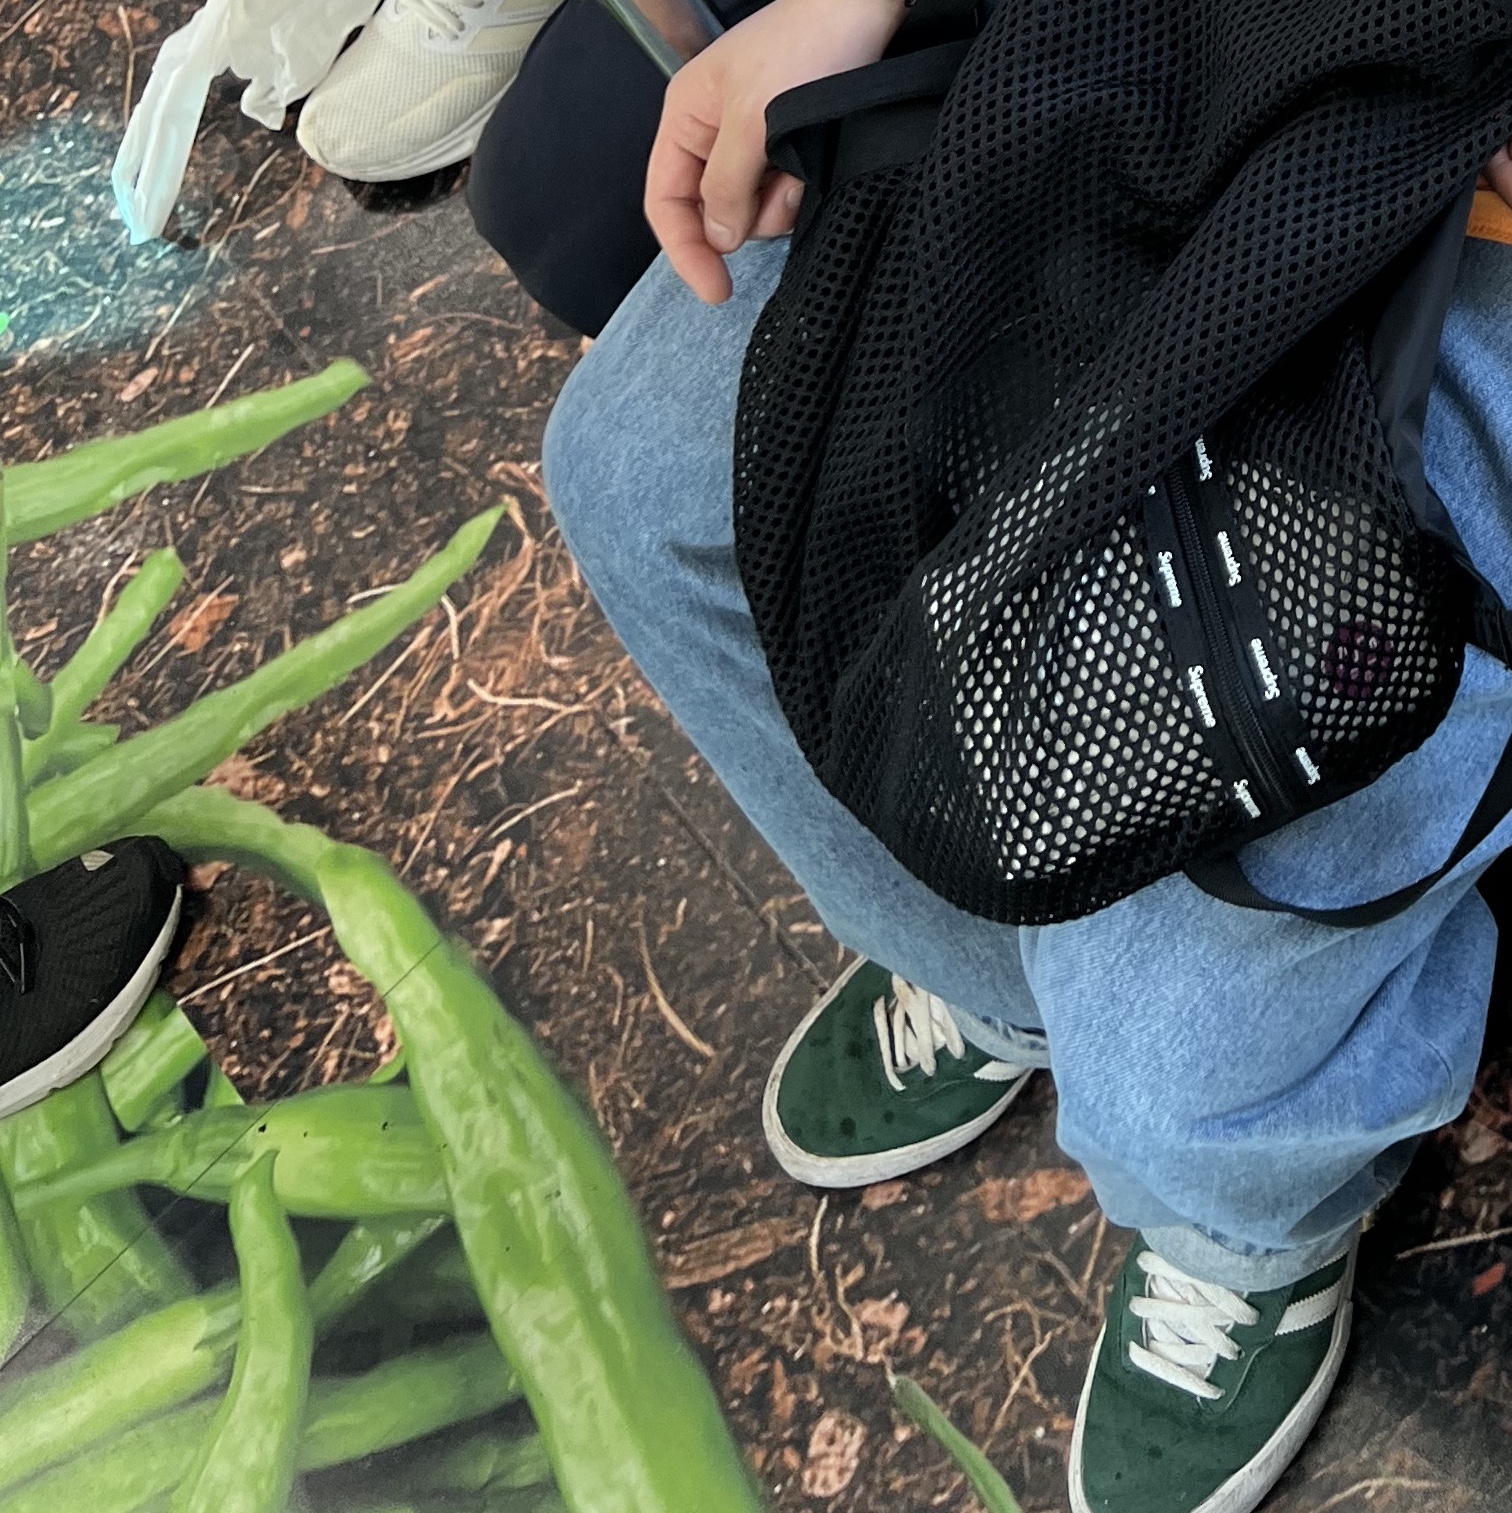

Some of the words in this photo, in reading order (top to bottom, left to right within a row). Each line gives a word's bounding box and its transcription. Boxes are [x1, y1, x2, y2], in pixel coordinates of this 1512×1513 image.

[1158, 551, 1182, 607] Supreme
[1217, 531, 1241, 586] Supreme
[1188, 666, 1216, 728] Supreme
[1251, 638, 1280, 700] Supreme
